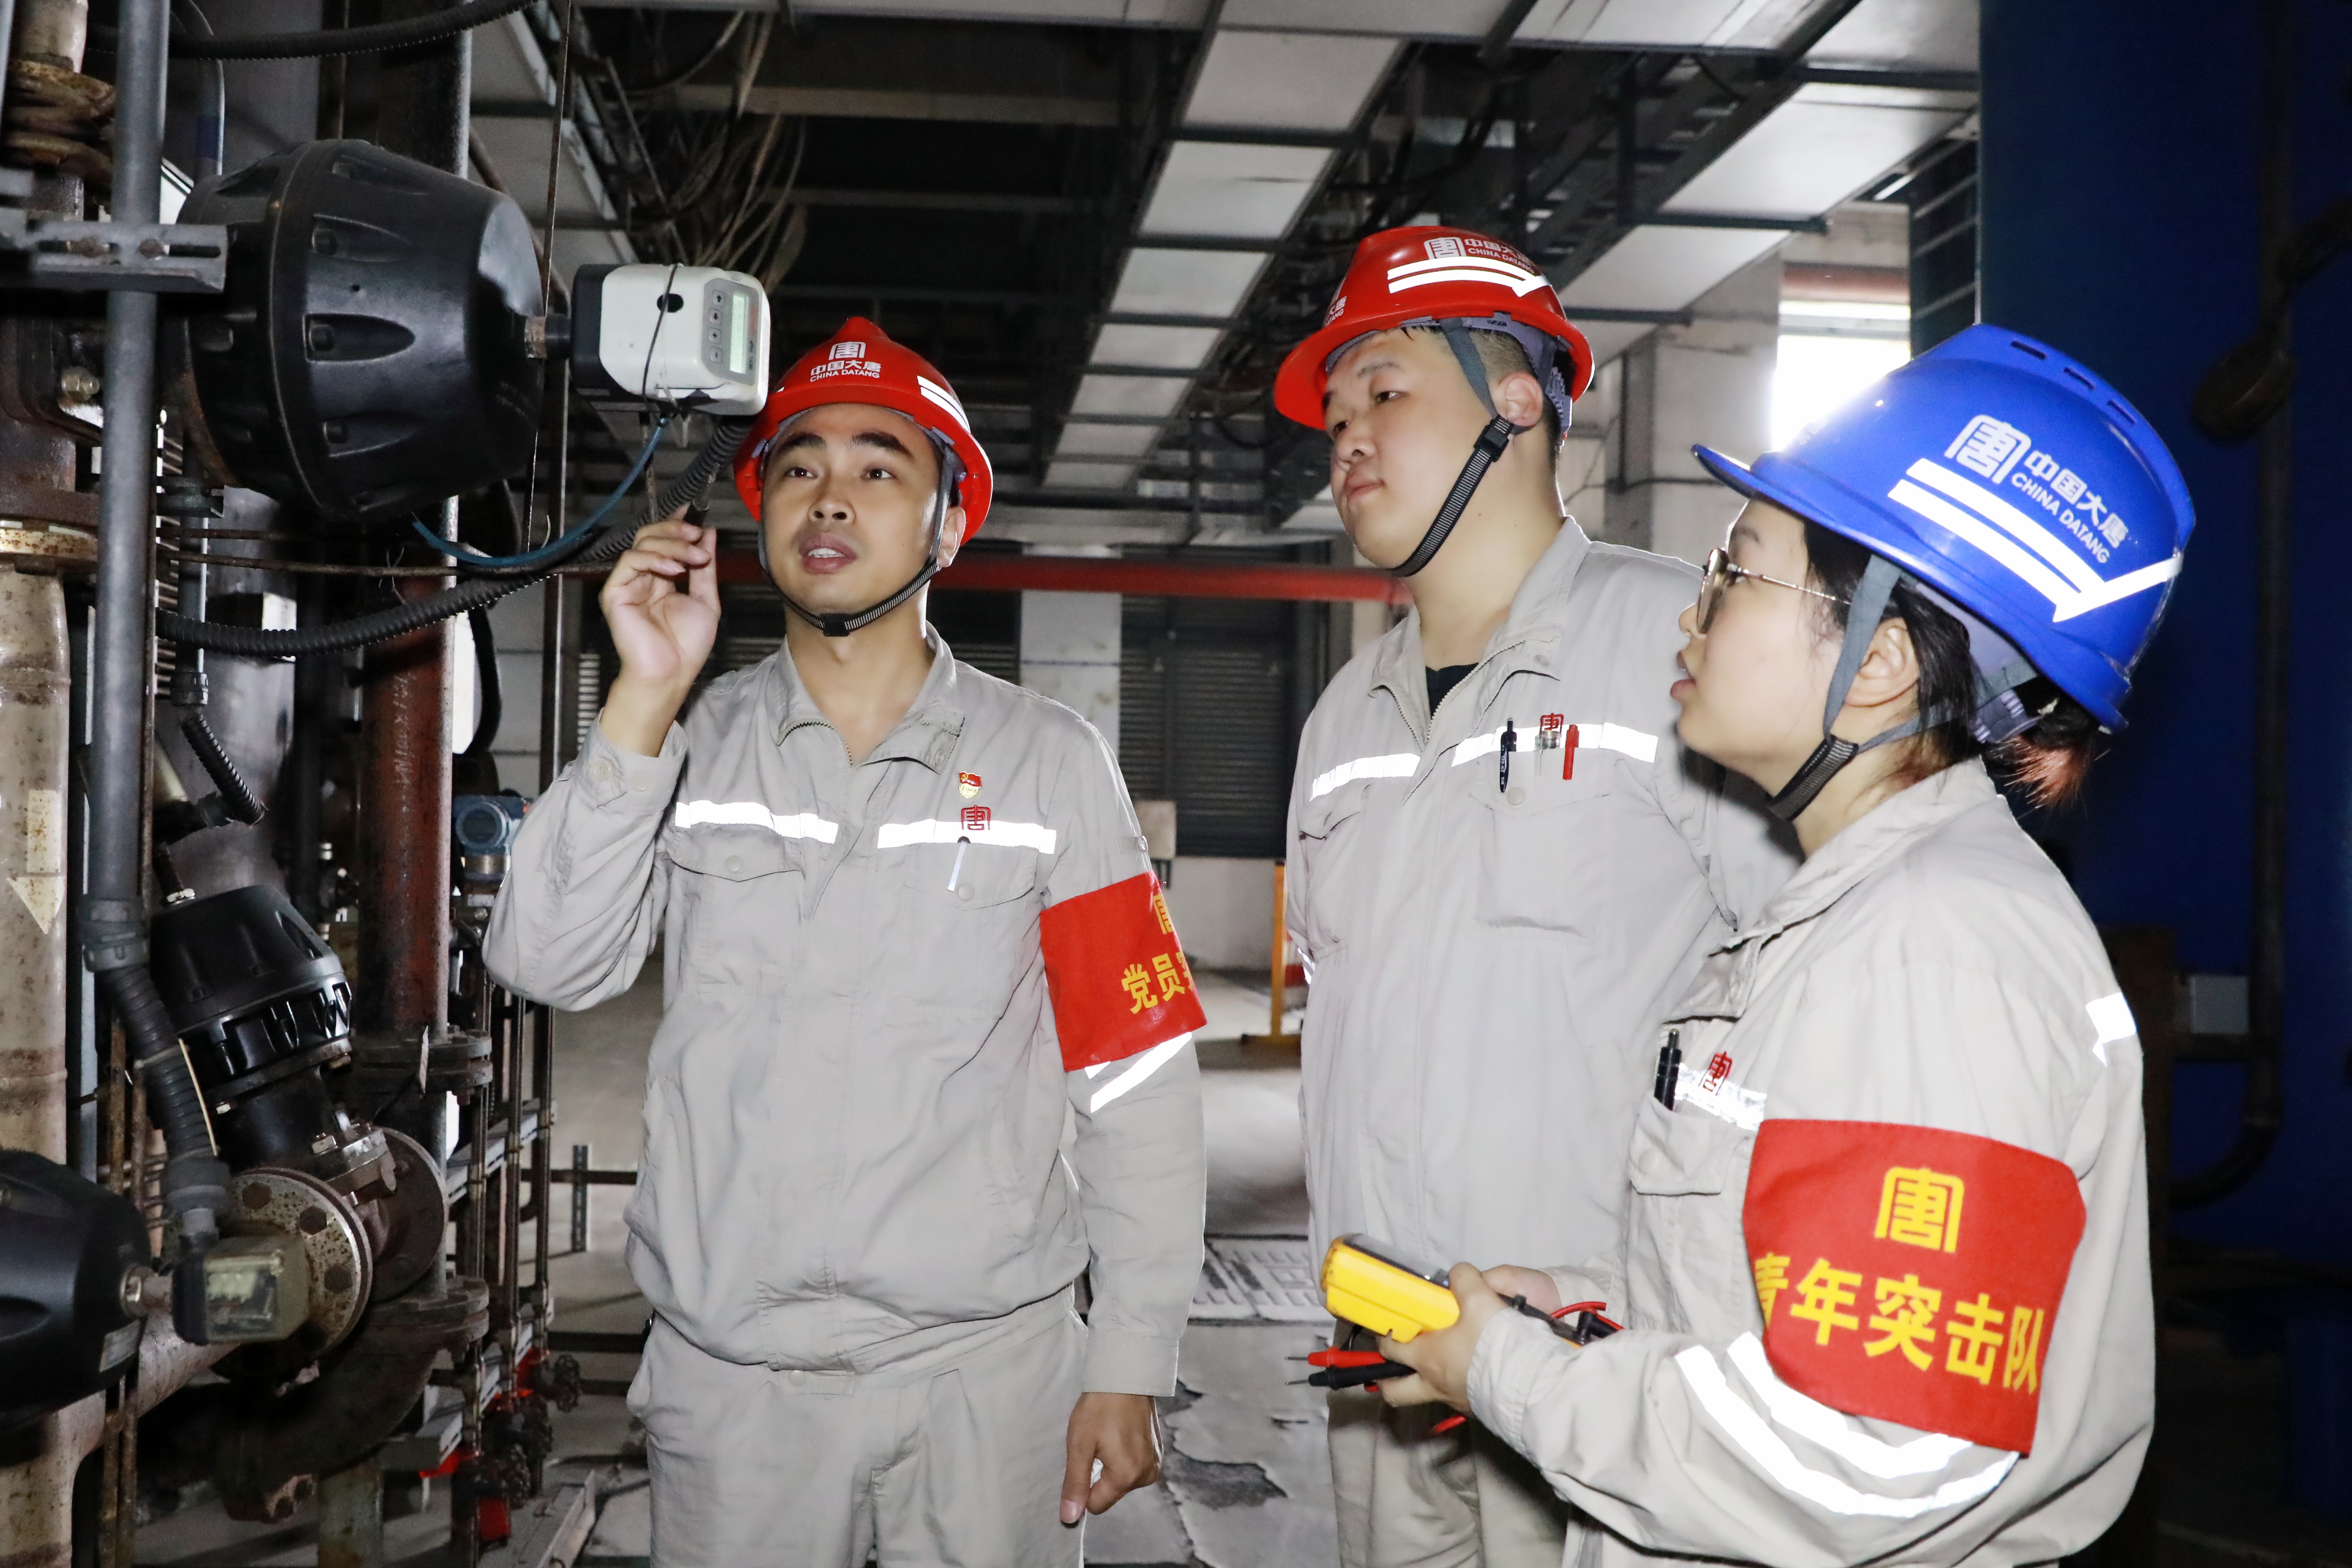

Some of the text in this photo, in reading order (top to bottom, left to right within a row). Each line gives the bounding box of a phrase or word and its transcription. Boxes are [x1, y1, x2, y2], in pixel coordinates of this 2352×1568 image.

[1467, 248, 1535, 274] CHINA DATANG
[810, 360, 881, 376] 中国大唐
[810, 369, 880, 382] CHINA DATANG
[2024, 449, 2128, 549] 中国大唐
[2011, 472, 2110, 564] CHINA DATANG
